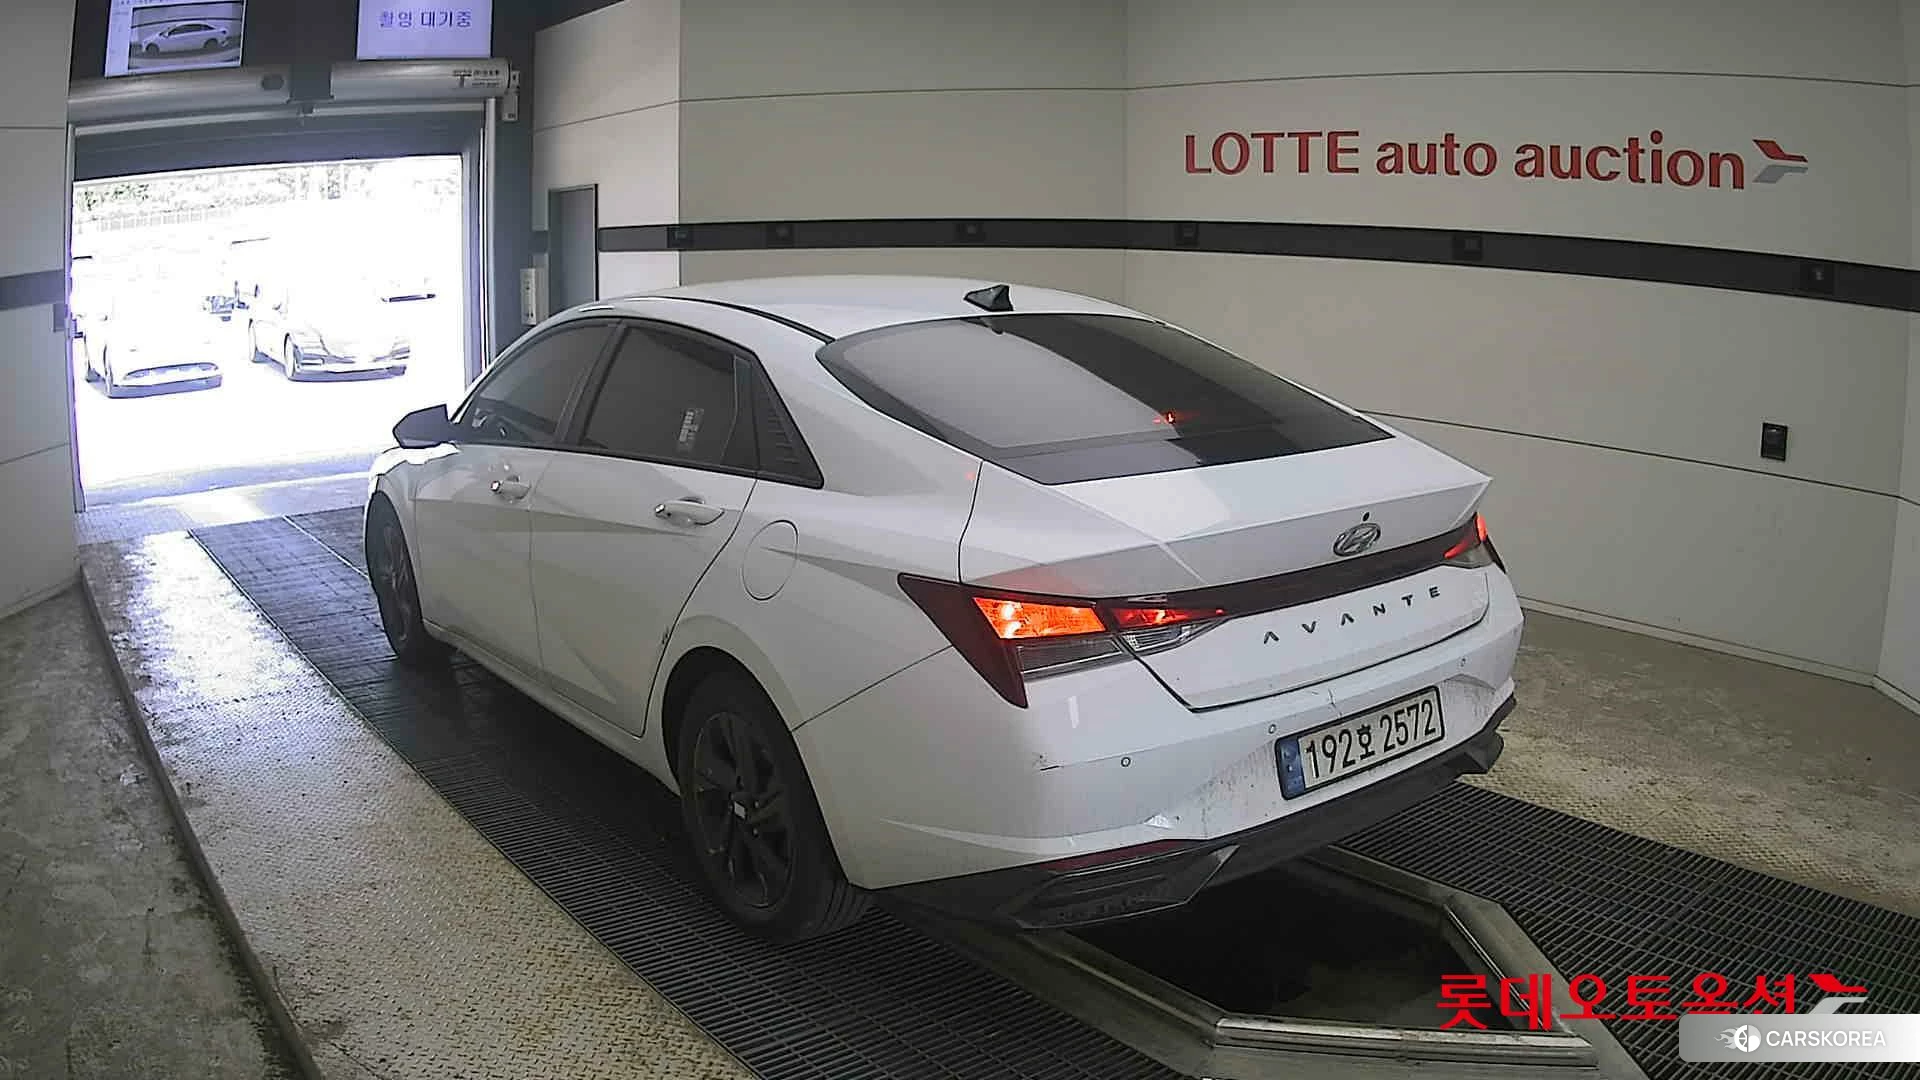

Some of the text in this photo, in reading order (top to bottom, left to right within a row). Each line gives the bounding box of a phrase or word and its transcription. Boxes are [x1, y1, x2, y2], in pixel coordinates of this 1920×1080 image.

[421, 10, 472, 28] 대기중
[1185, 130, 1745, 189] LOTTE auto auction
[1263, 586, 1441, 645] AVANTE
[1304, 699, 1437, 779] 192호 2572
